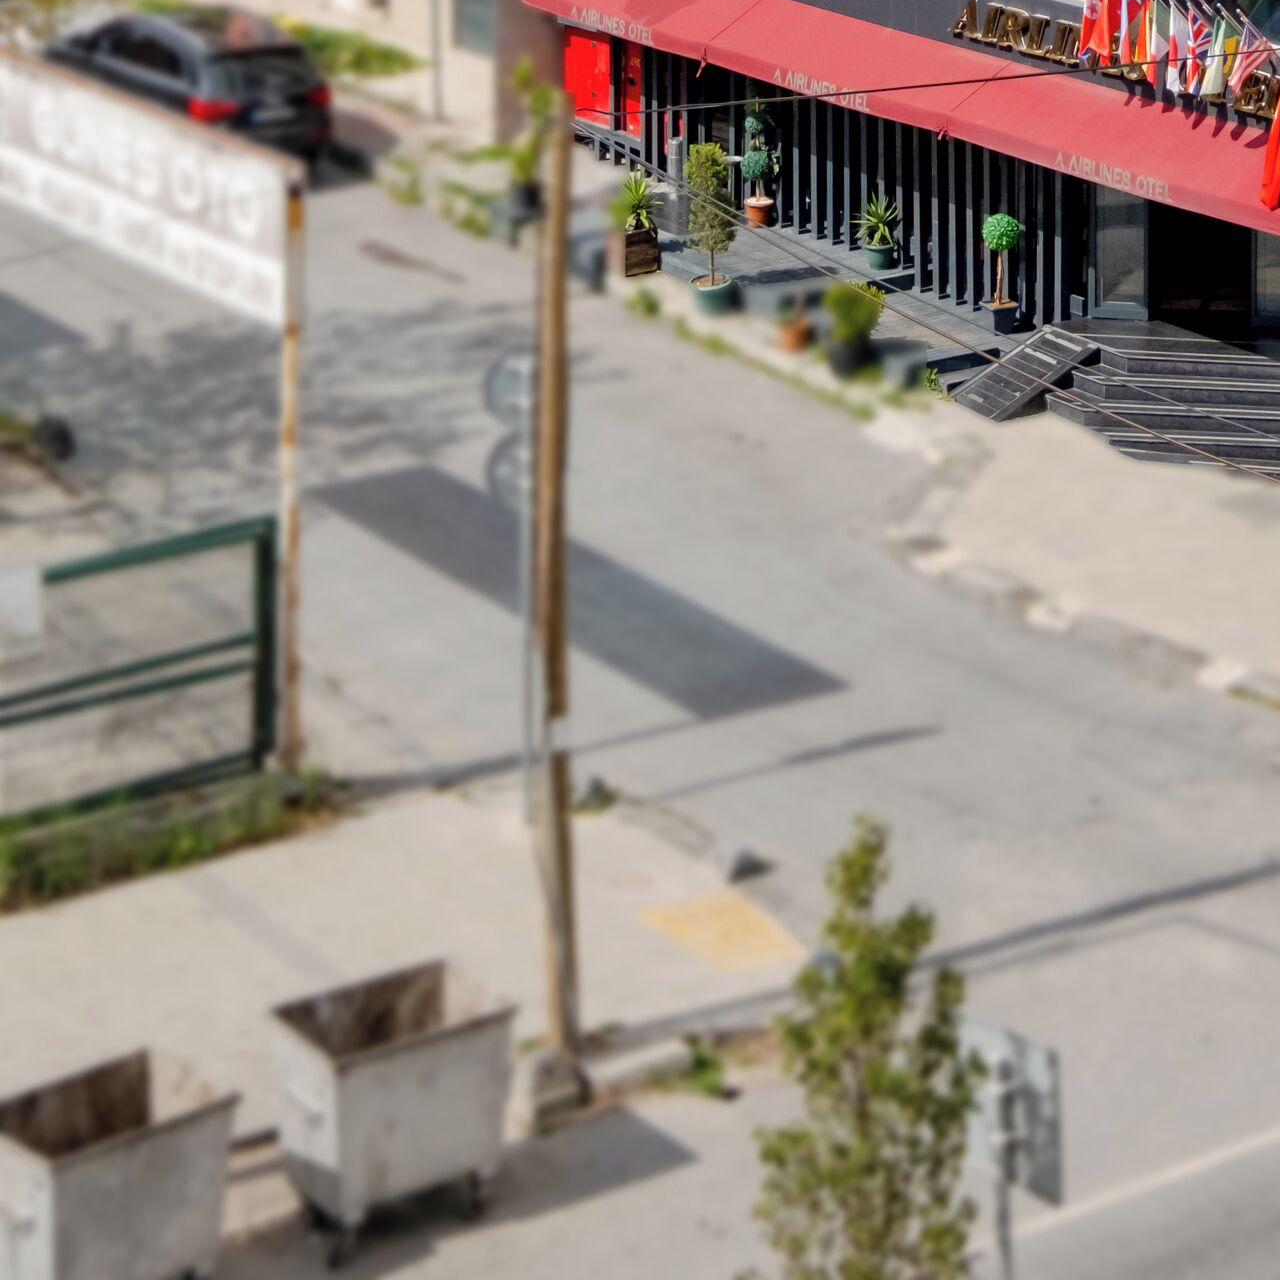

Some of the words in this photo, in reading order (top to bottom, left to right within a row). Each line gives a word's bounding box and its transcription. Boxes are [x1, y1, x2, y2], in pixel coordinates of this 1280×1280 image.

[580, 7, 625, 37] AIRLINES
[628, 23, 654, 45] OTEL
[785, 70, 836, 102] AIRLINES
[840, 87, 870, 112] OTEL
[1068, 155, 1131, 190] AIRLINES
[1136, 175, 1174, 203] OTEL
